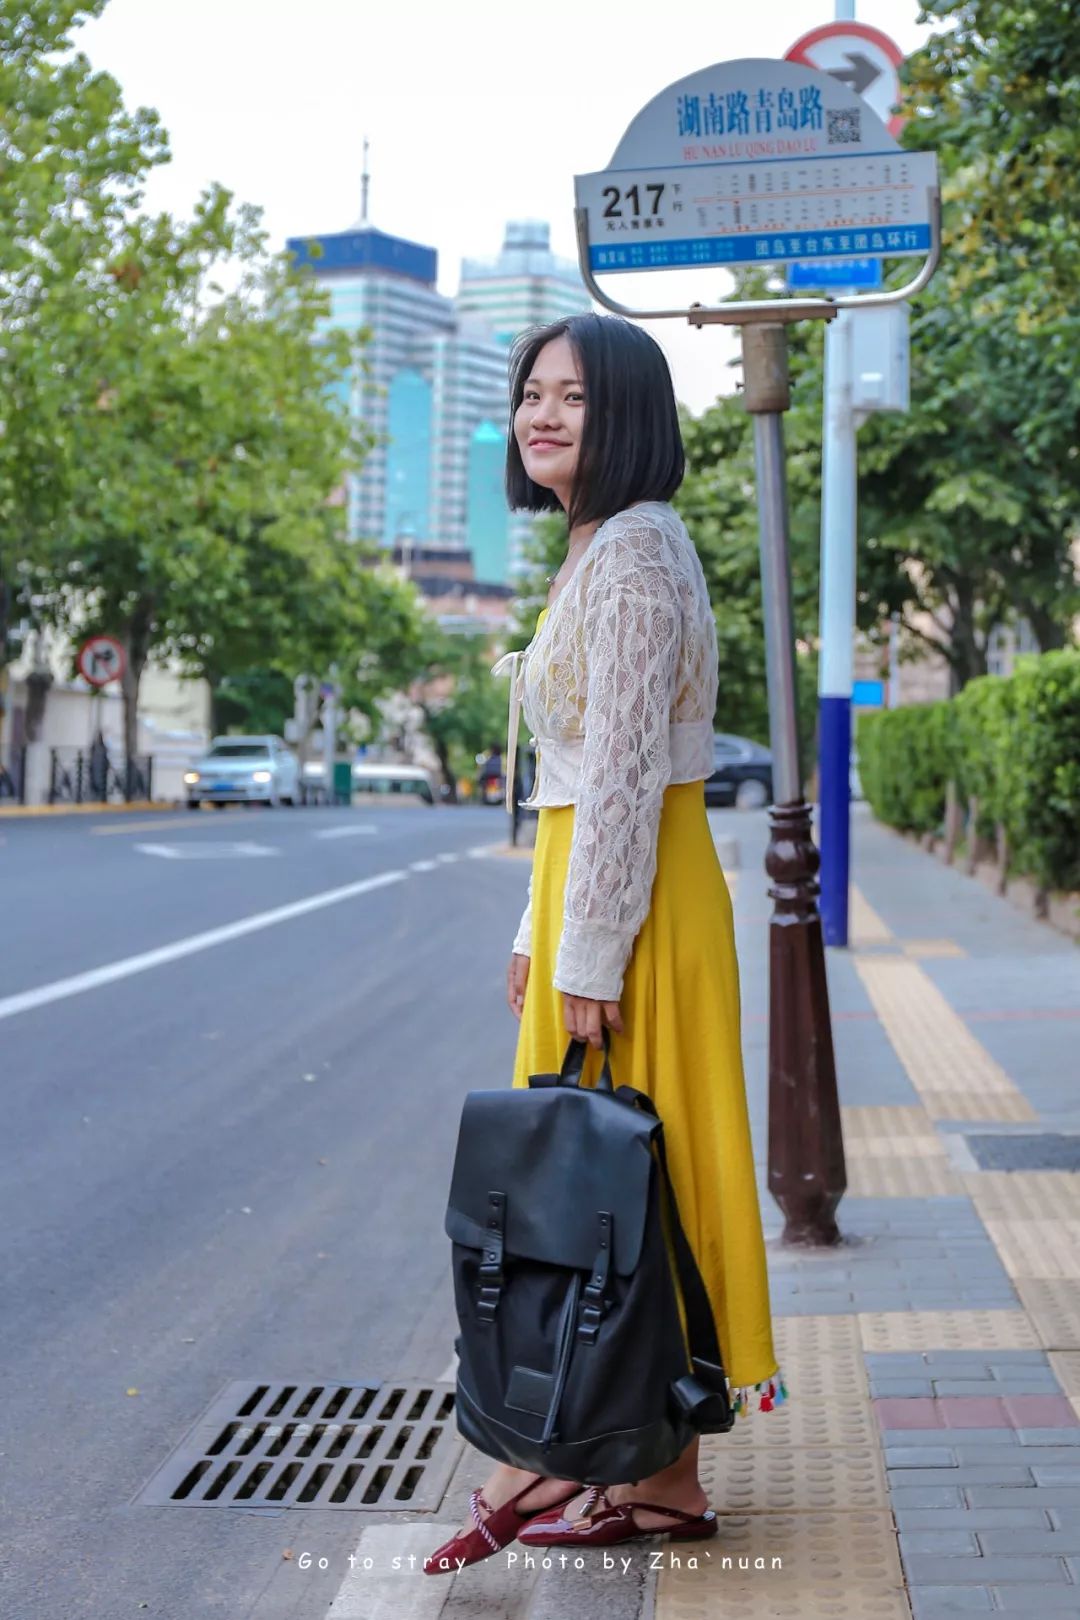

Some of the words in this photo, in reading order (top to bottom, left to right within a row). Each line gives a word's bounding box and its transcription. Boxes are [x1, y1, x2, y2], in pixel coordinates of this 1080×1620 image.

[677, 85, 823, 137] 湖南路青岛路
[703, 144, 727, 159] NAN
[602, 183, 665, 218] 217
